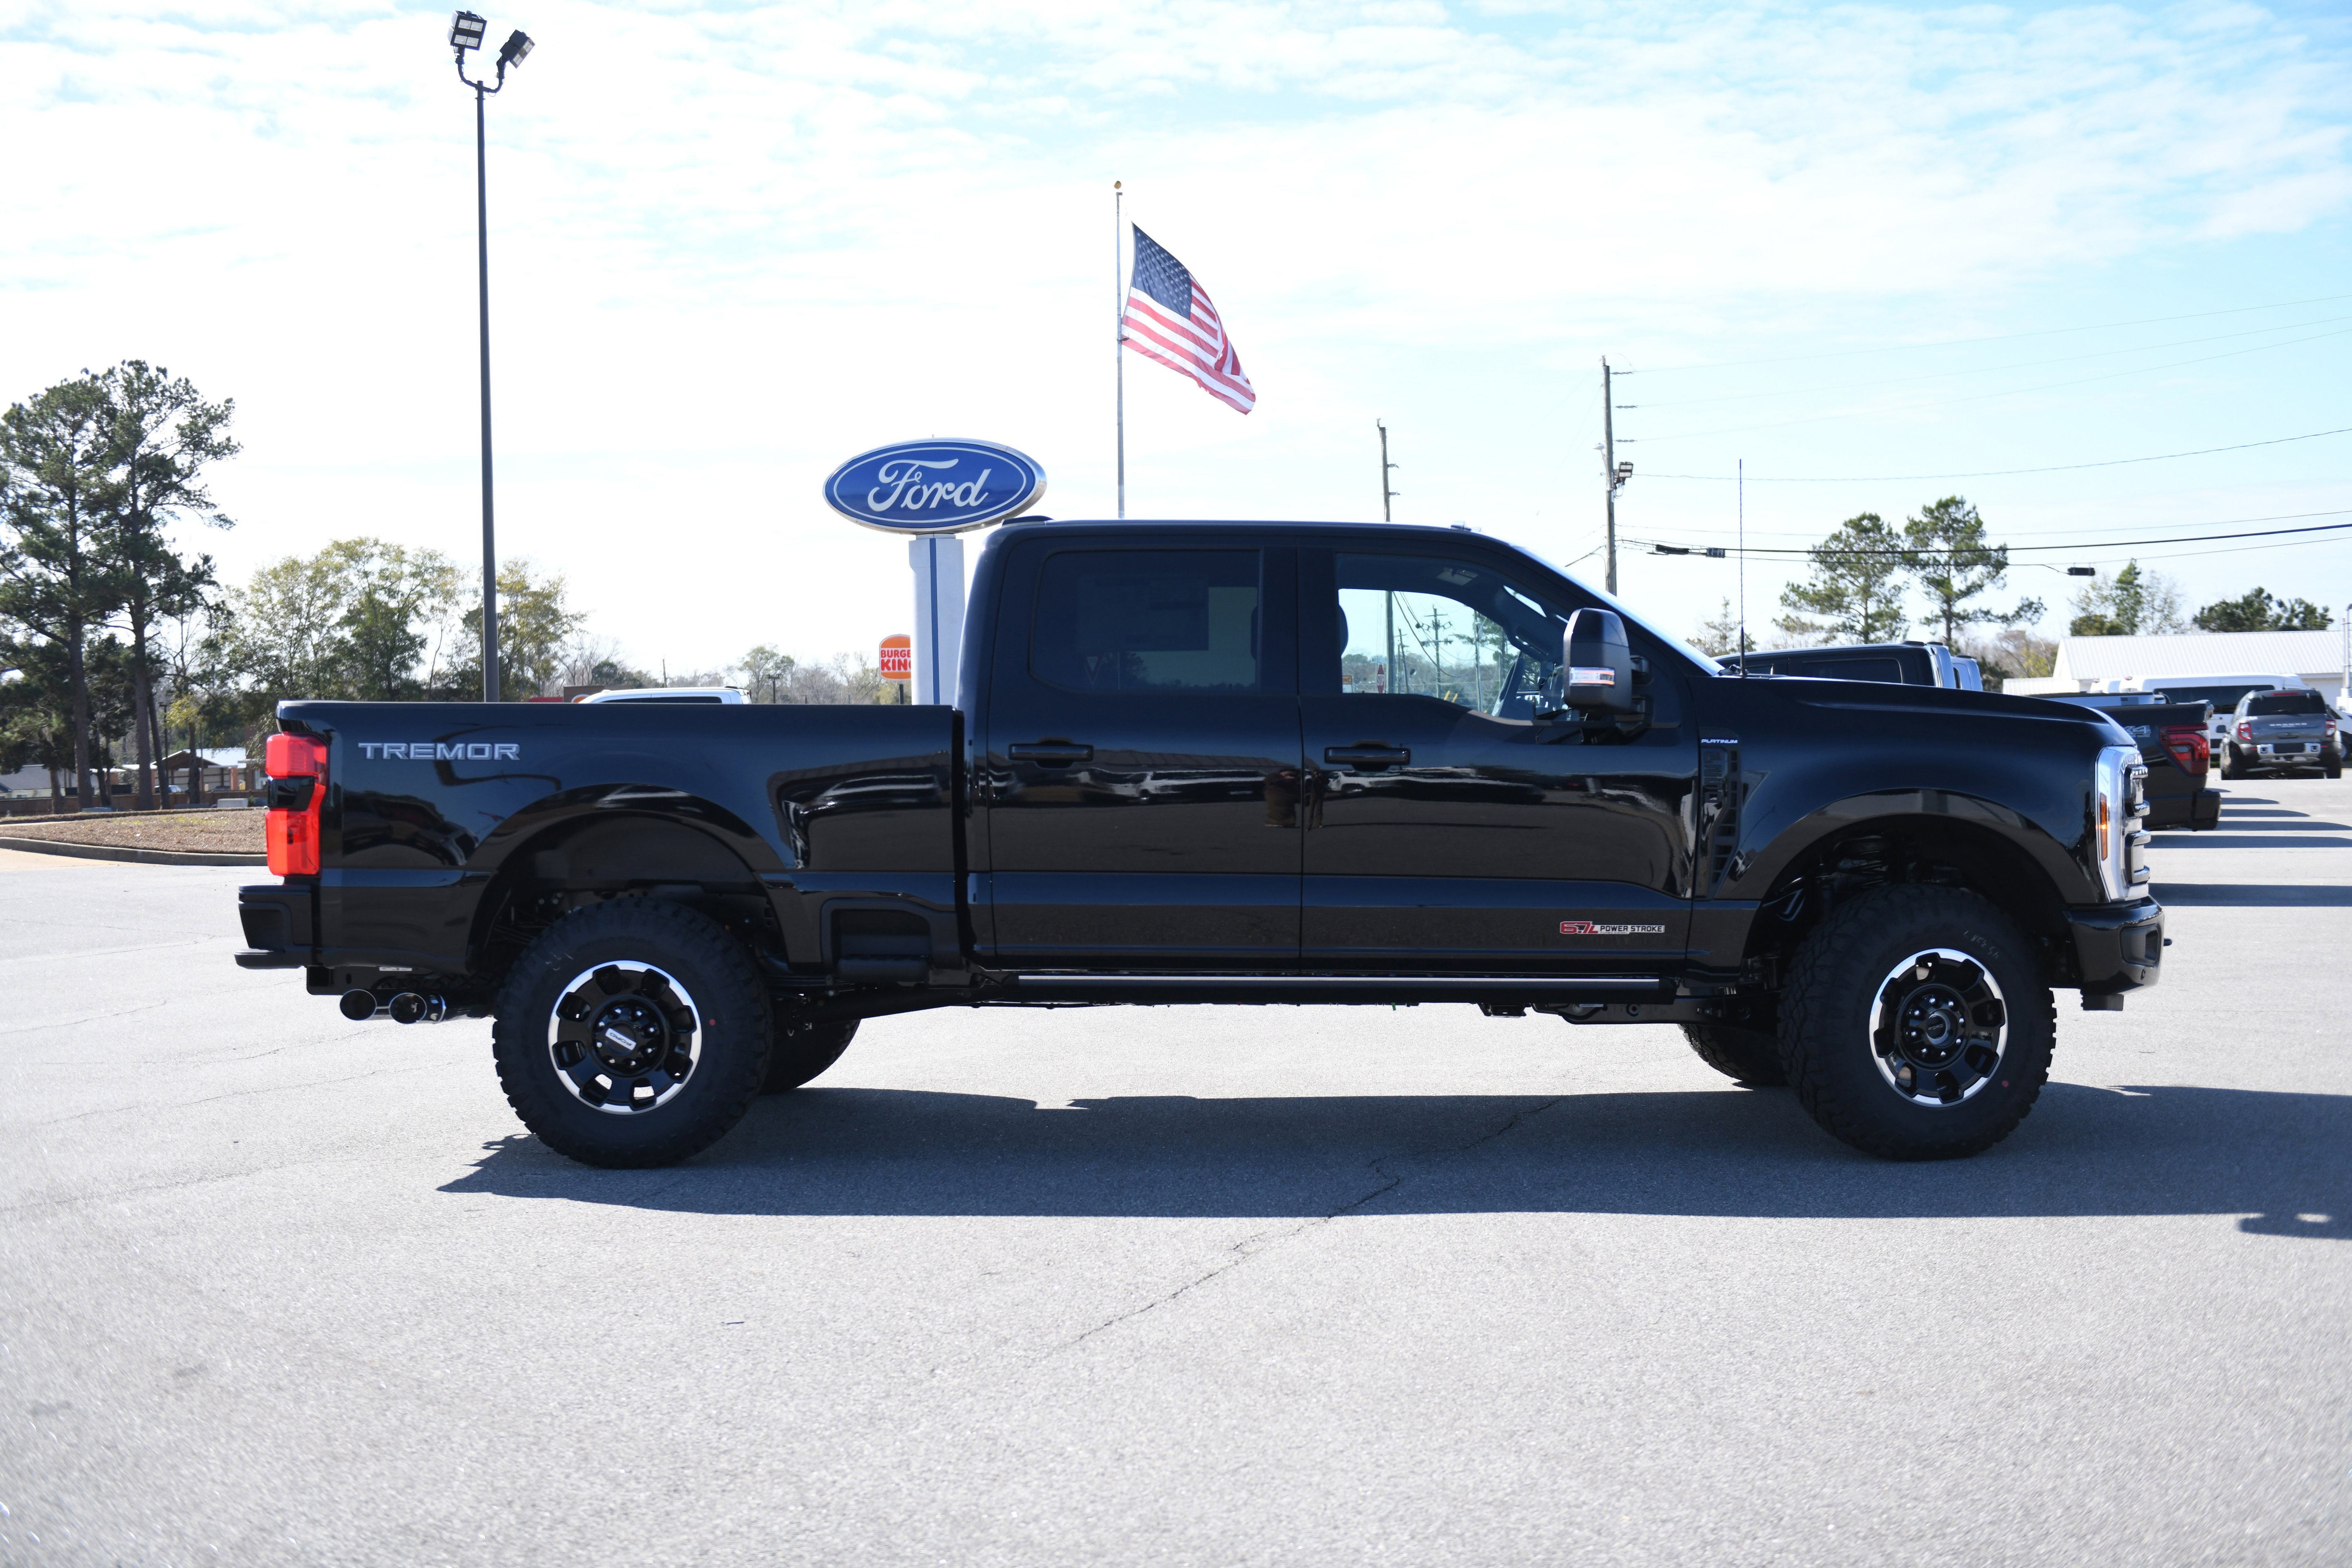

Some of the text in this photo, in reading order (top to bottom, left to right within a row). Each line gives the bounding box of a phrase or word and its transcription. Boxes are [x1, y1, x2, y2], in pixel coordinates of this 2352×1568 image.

[867, 458, 991, 512] Ford
[881, 650, 911, 658] BURGE
[881, 659, 911, 671] KIN
[2125, 725, 2150, 734] X4
[358, 742, 520, 760] TREMOR
[1560, 922, 1598, 933] 6.7L
[610, 1033, 632, 1046] FORD
